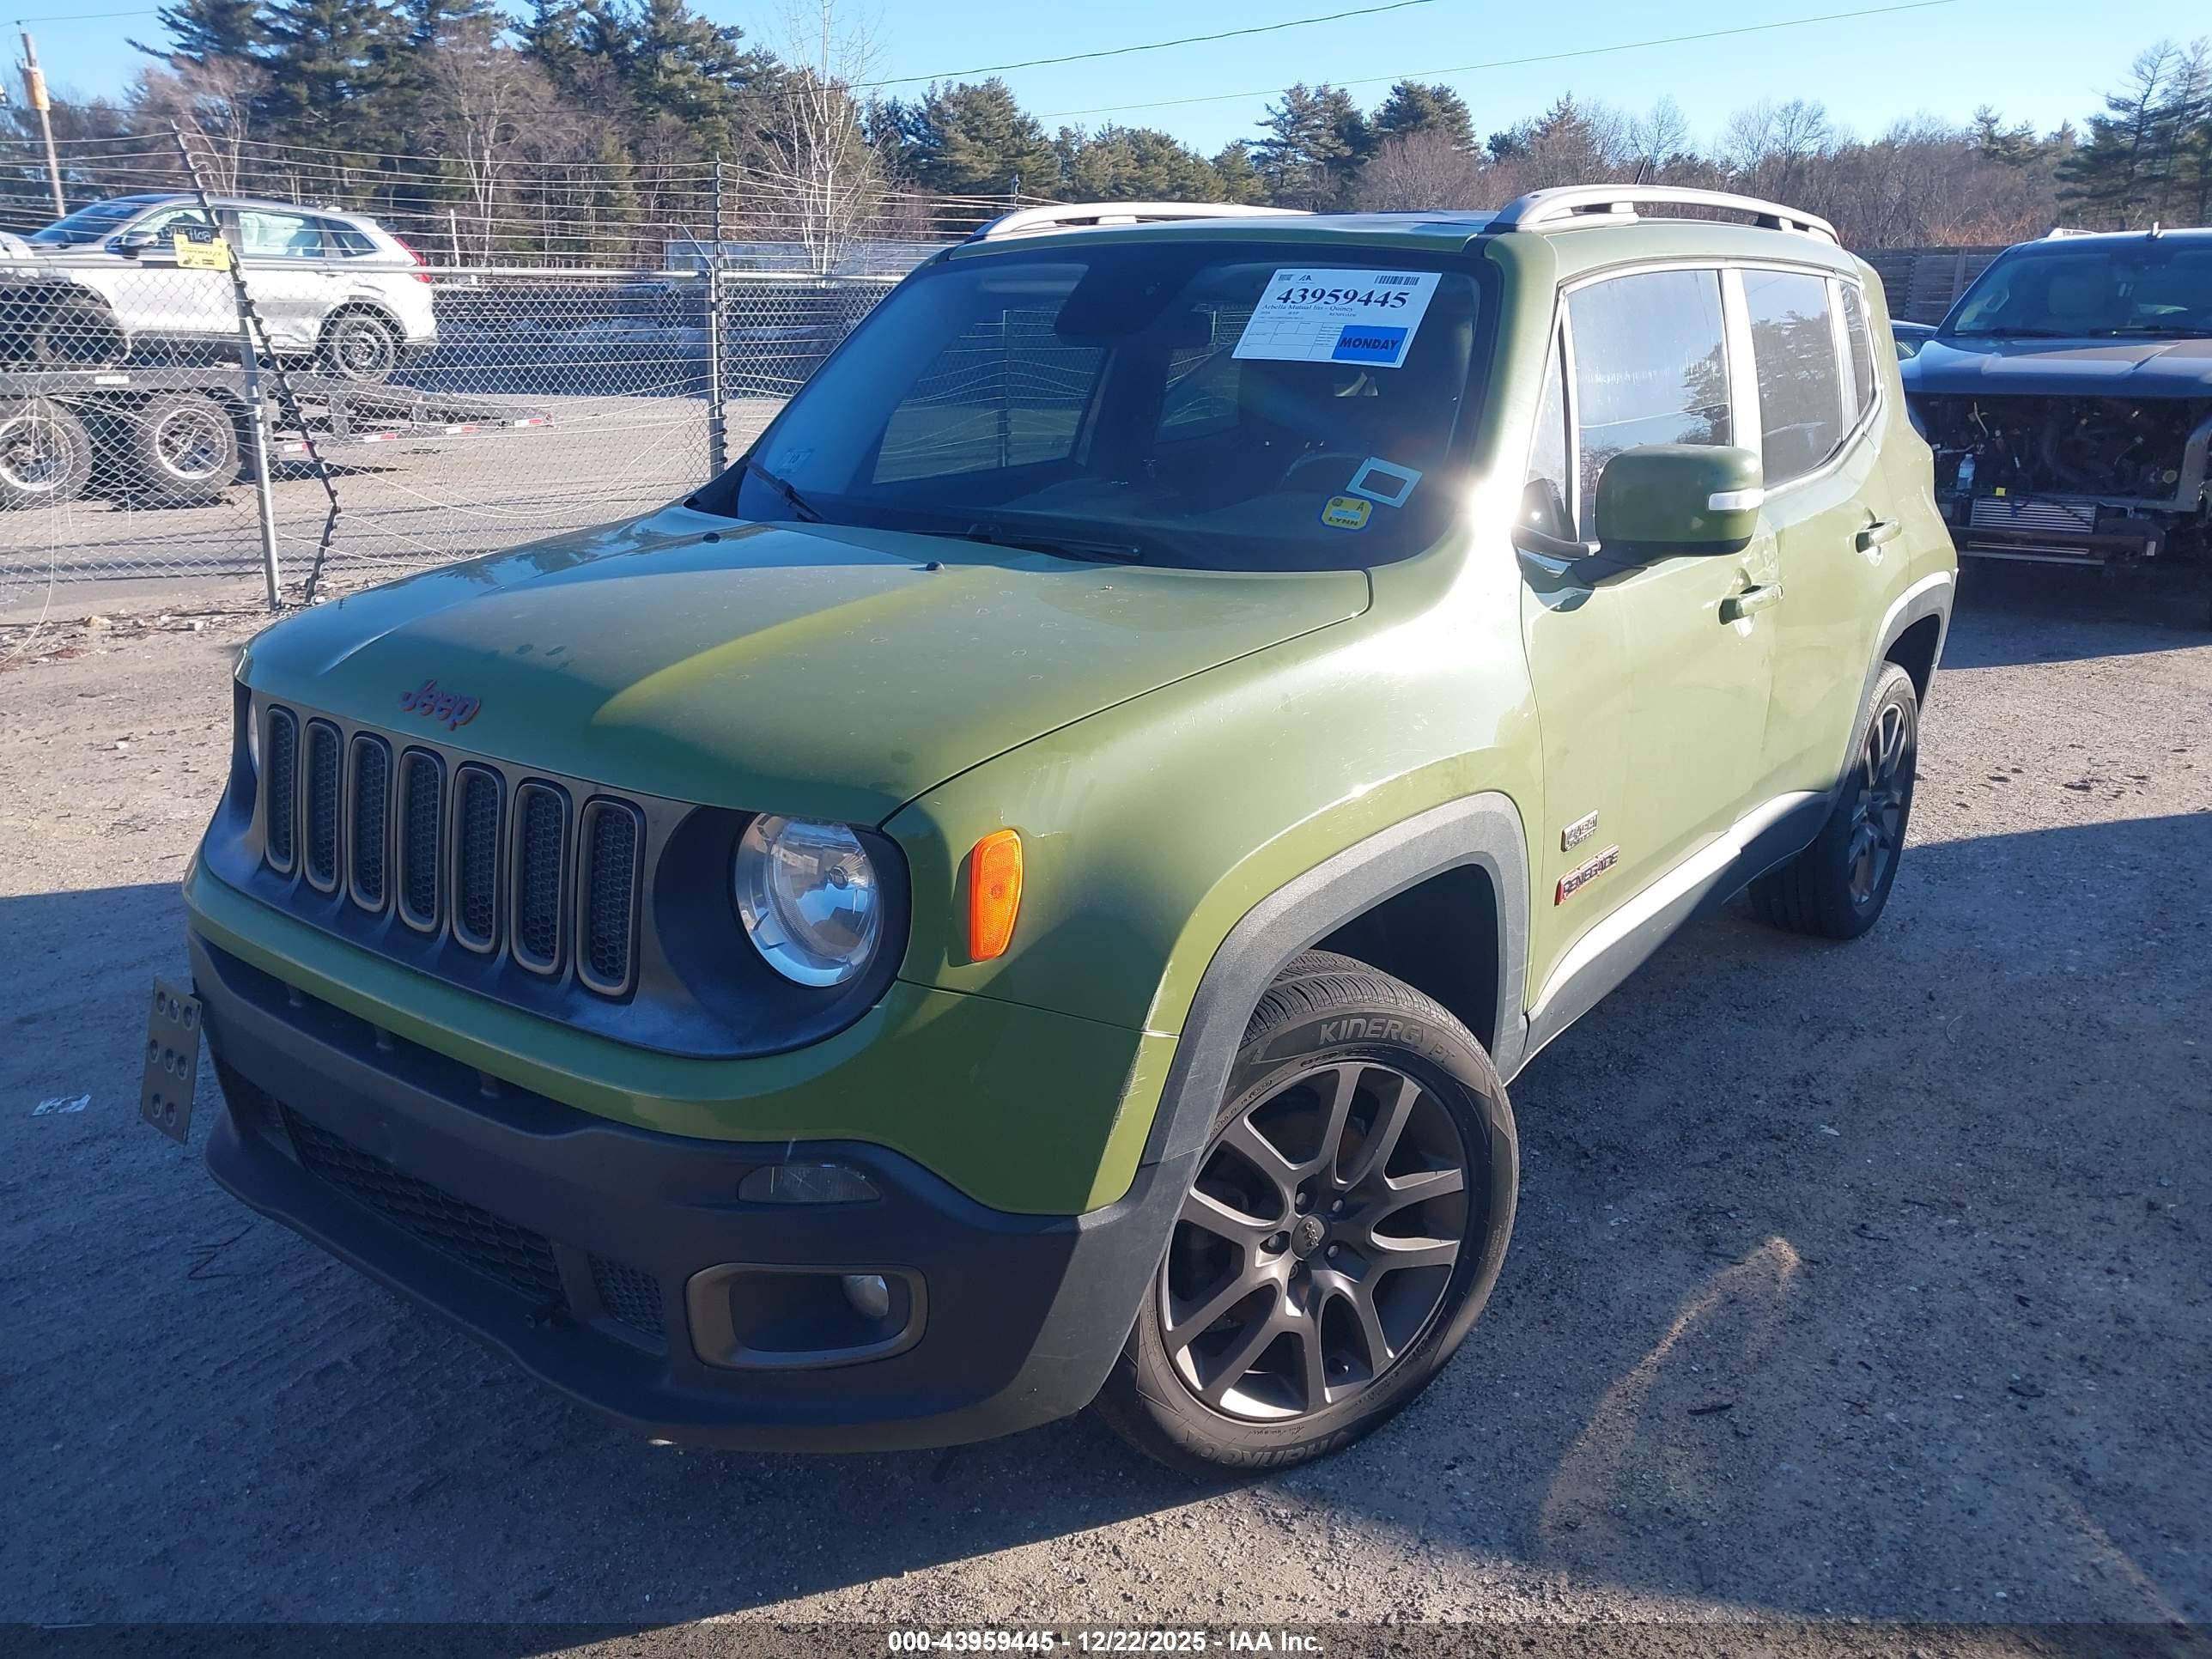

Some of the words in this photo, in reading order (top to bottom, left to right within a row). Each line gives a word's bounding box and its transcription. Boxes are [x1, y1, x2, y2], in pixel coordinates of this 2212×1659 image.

[1276, 287, 1411, 308] 43959445
[1338, 336, 1400, 351] MONDAY
[1328, 516, 1358, 526] LYNN
[398, 678, 481, 732] Jeep
